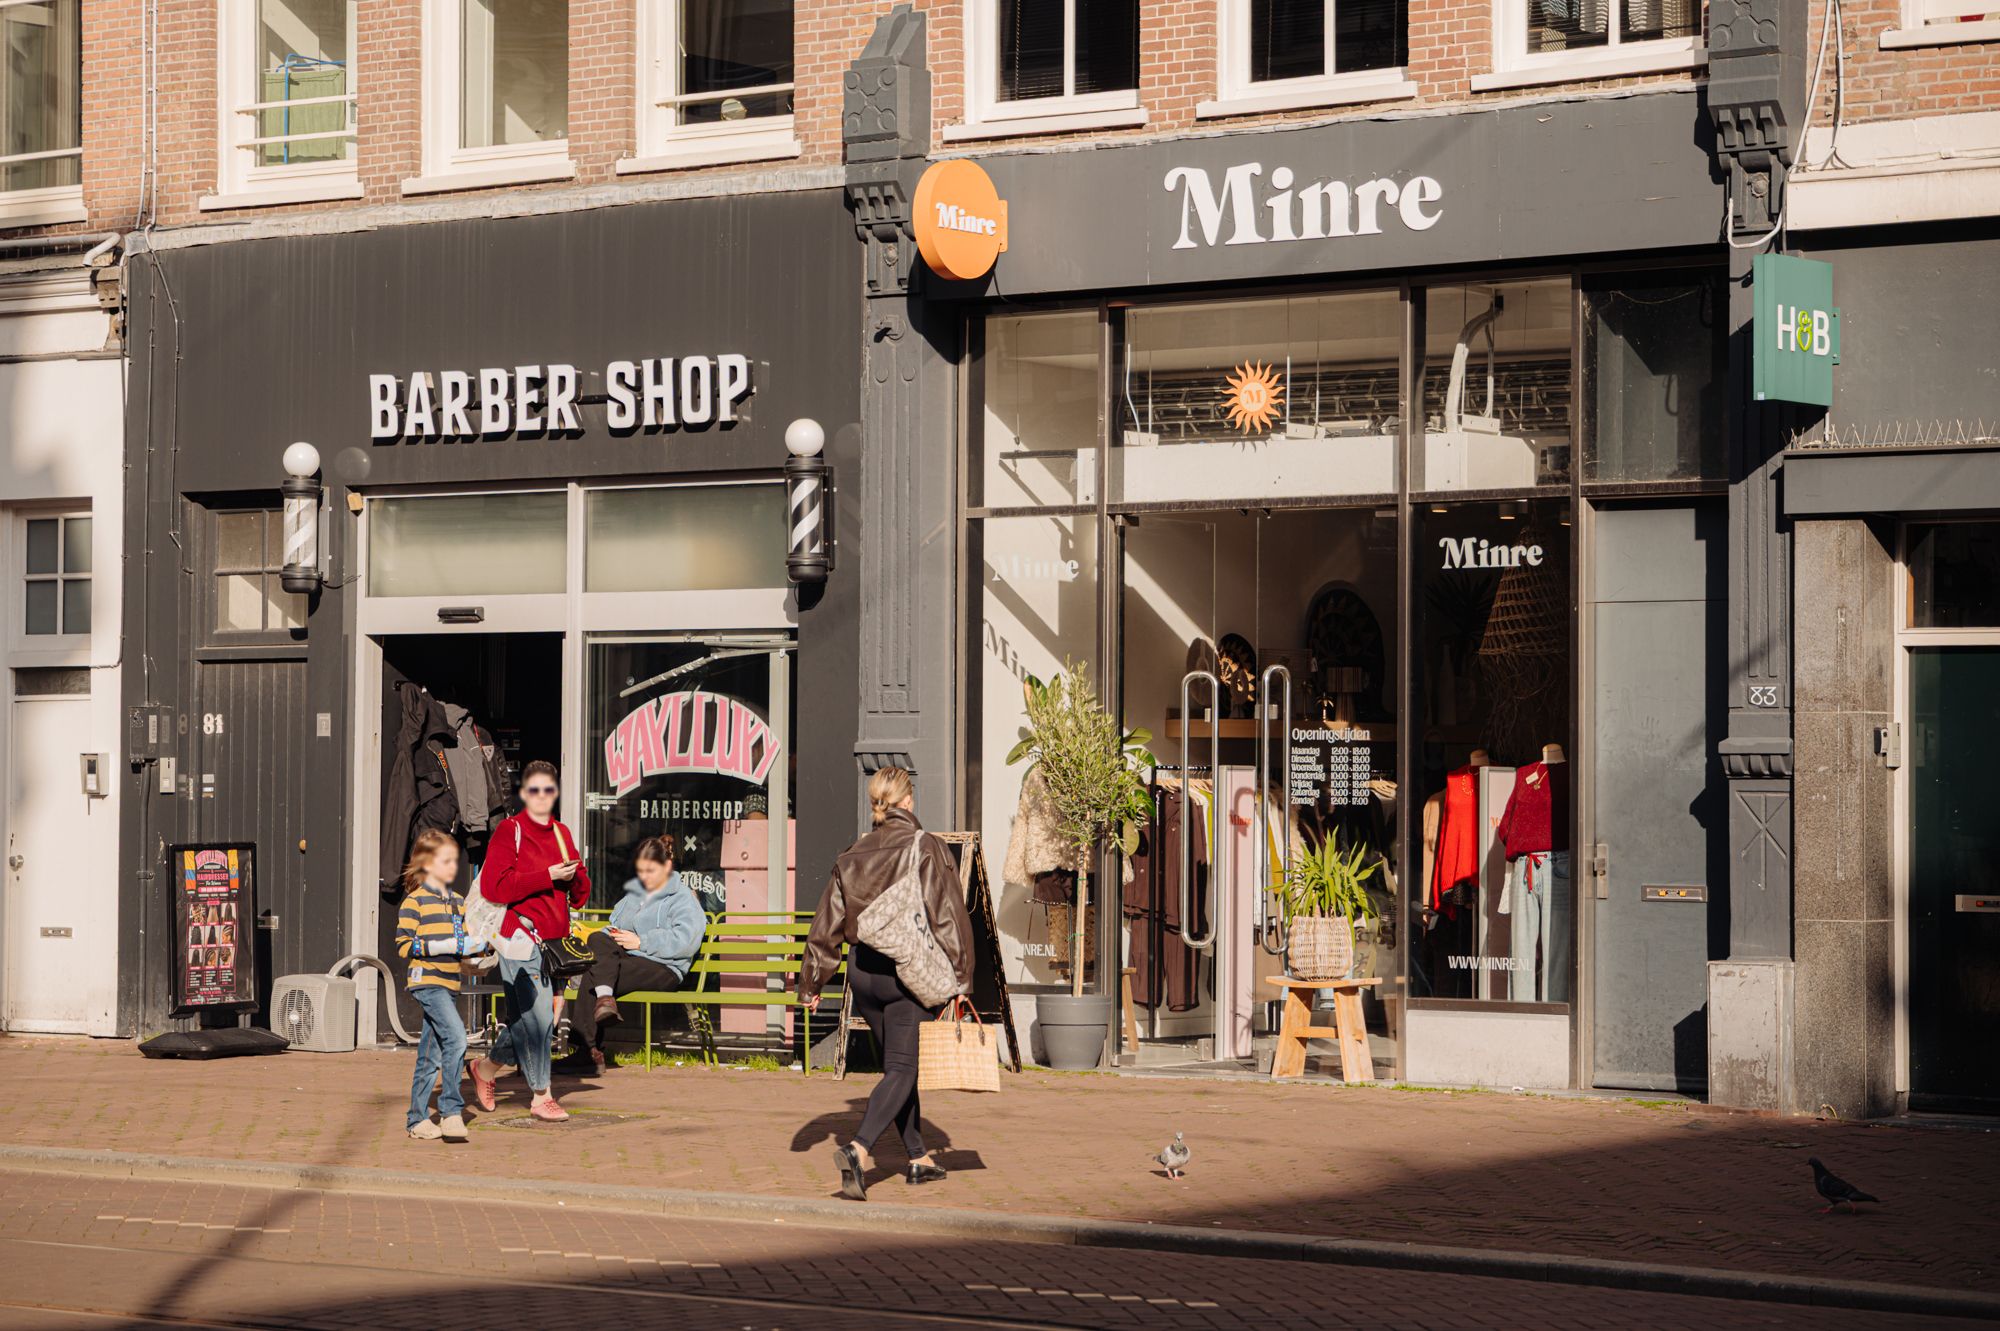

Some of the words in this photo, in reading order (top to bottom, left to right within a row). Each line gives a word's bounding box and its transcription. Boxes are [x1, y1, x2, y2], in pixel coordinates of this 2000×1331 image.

[1164, 162, 1444, 250] Minre
[935, 202, 997, 236] Minre
[369, 364, 582, 438] BARBER
[606, 353, 752, 430] SHOP
[1439, 537, 1543, 569] Minre
[1750, 686, 1777, 706] 83
[203, 713, 224, 735] 81
[1292, 728, 1371, 743] Openingstijden
[1291, 747, 1320, 757] Maandag
[1291, 755, 1316, 765] Dinsdag
[1291, 763, 1324, 773] Woensdag
[1291, 772, 1326, 782] Donderdag
[1291, 780, 1313, 790] Vrijdag
[1291, 788, 1320, 798] Zaterdag
[640, 799, 743, 820] BARBERSHOP
[1291, 797, 1315, 807] Zondag
[1447, 955, 1533, 971] WWW.MINRE.NL
